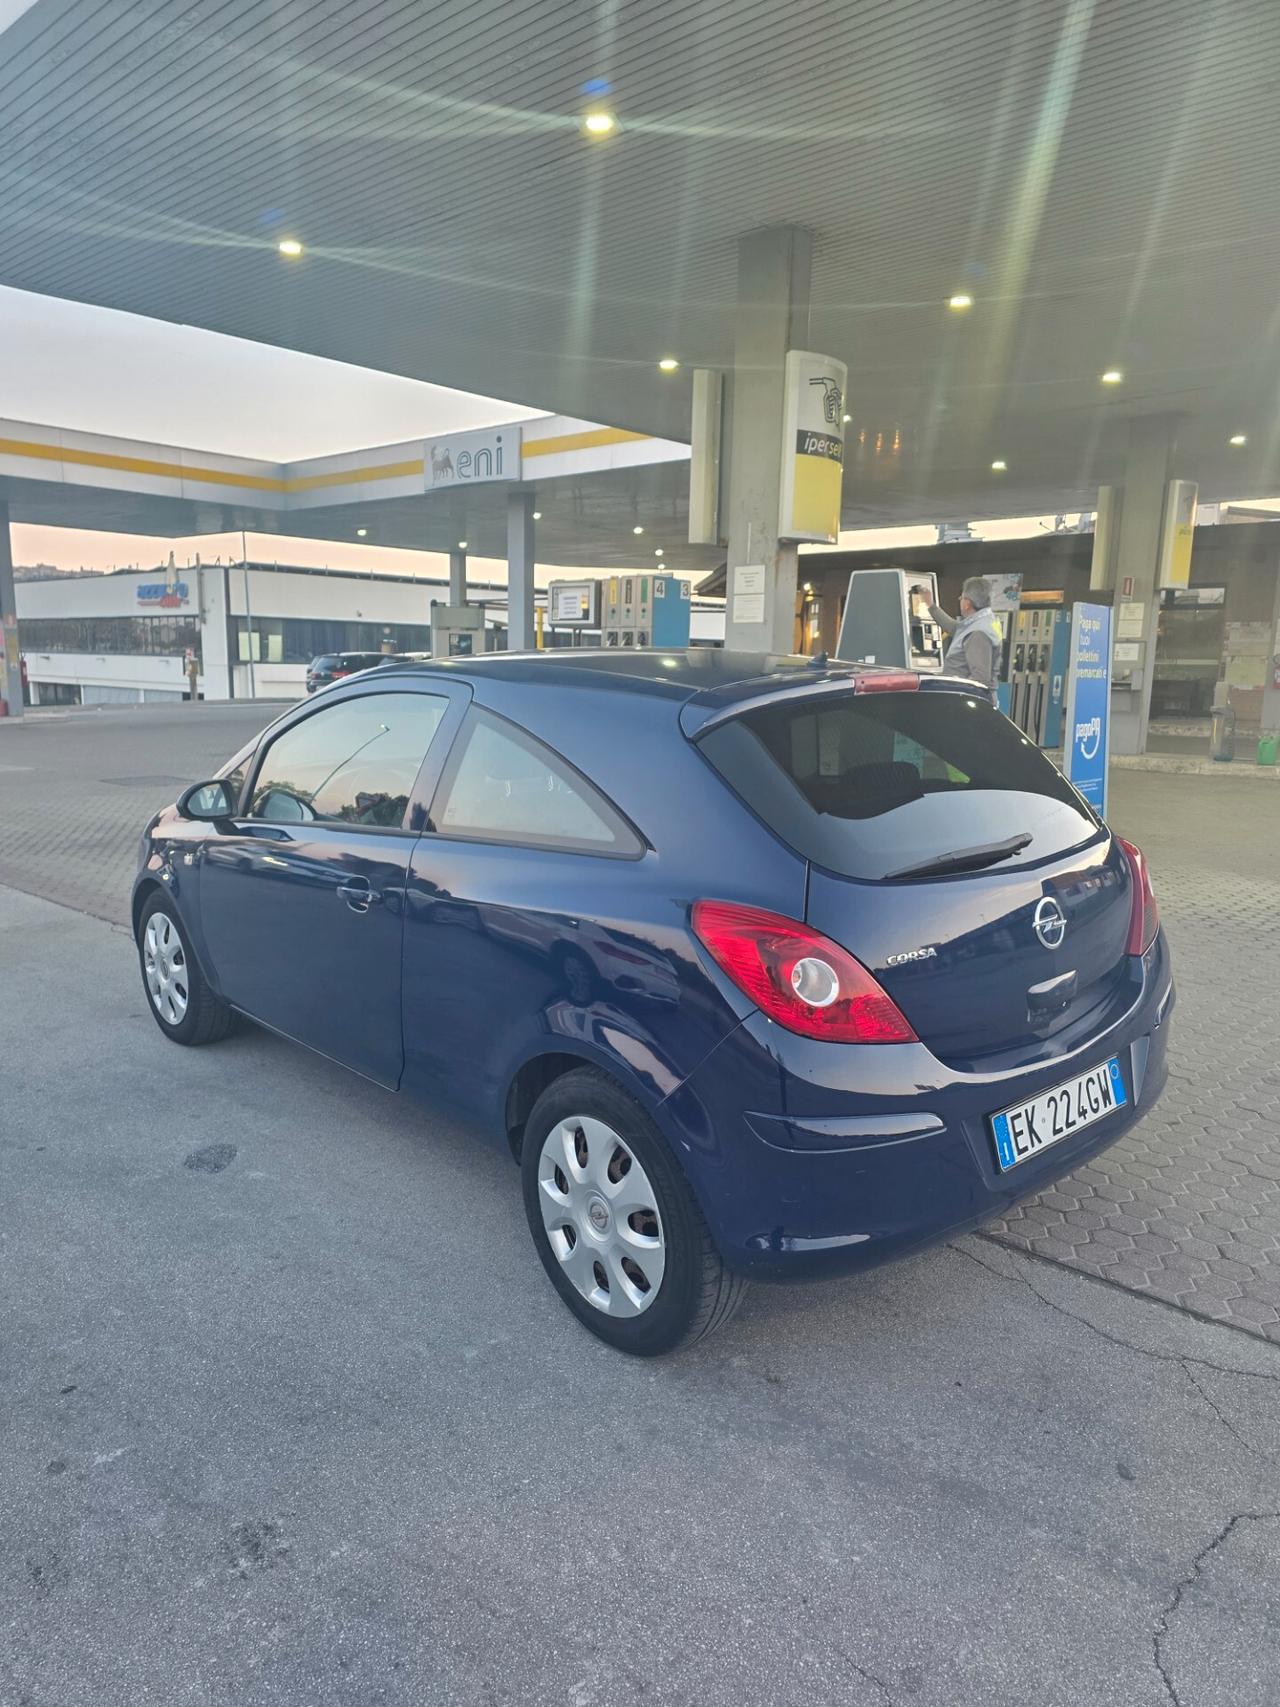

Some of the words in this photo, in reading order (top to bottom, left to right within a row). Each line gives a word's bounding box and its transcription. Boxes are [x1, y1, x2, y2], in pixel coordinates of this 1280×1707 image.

[457, 435, 503, 479] eni
[804, 432, 841, 458] ipersel
[655, 581, 664, 597] 4
[682, 583, 690, 597] 3
[1075, 717, 1101, 743] pagoPA
[886, 947, 938, 966] CORSA
[1010, 1105, 1043, 1156] EK
[1047, 1069, 1112, 1137] 224GW
